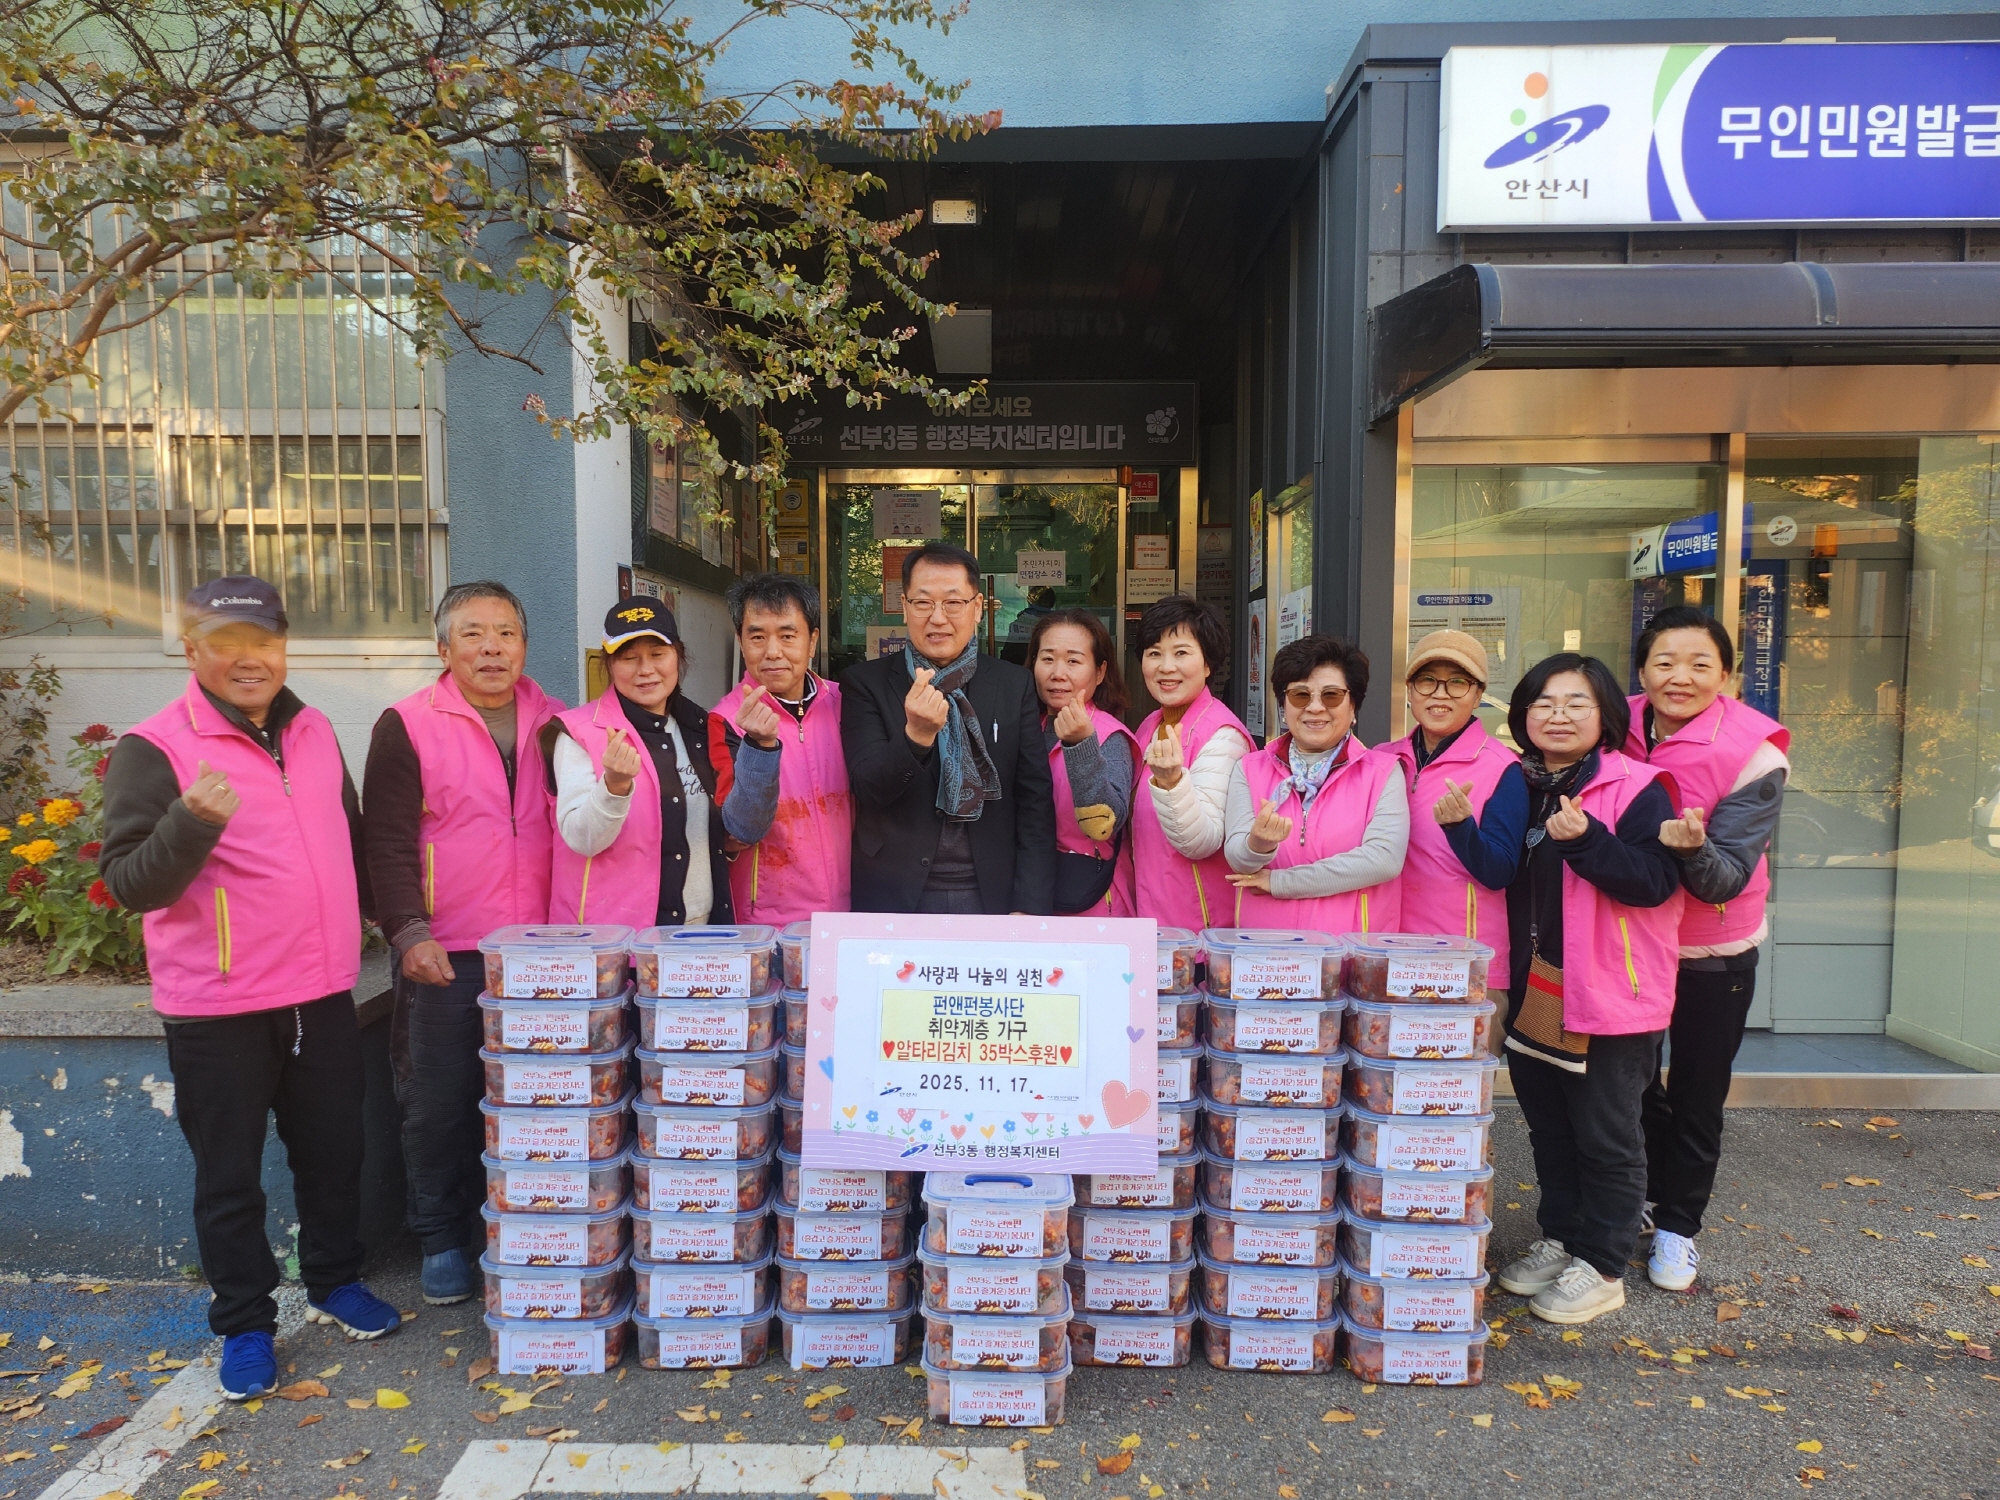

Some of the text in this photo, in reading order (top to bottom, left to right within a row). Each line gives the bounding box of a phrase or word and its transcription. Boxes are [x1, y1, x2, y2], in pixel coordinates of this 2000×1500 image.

[1718, 105, 2000, 160] 무인민원발급
[1504, 177, 1589, 201] 안산시
[786, 435, 823, 445] 안산시
[839, 424, 1126, 451] 선부3동 행정복지센터입니다
[1022, 560, 1061, 569] 주민자치회
[1020, 570, 1063, 579] 면접장소 2층
[221, 596, 263, 605] Columbia
[565, 975, 588, 983] 봉사단
[720, 974, 742, 982] 봉사단
[918, 965, 1043, 988] 사랑과 나눔의 실천
[1290, 975, 1312, 983] 봉사단
[1443, 973, 1465, 981] 봉사단
[933, 995, 1025, 1018] 펀앤펀봉사단
[560, 1024, 583, 1033] 봉사단
[928, 1018, 1028, 1042] 취약계층 가구
[896, 1040, 1058, 1066] 알타리김치 35박스후원
[717, 1080, 739, 1088] 봉사단
[920, 1074, 1034, 1094] 2025. 11. 17.
[1296, 1079, 1319, 1087] 봉사단
[1452, 1090, 1474, 1098] 봉사단
[558, 1138, 581, 1146] 봉사단
[933, 1143, 1060, 1160] 선부3동 행정복지센터
[709, 1189, 731, 1197] 봉사단
[857, 1188, 878, 1196] 봉사단
[1291, 1188, 1313, 1196] 봉사단
[1011, 1232, 1035, 1240] 봉사단
[707, 1239, 729, 1247] 봉사단
[1141, 1238, 1162, 1246] 봉사단
[559, 1243, 581, 1251] 봉사단
[1440, 1256, 1463, 1264] 봉사단
[1008, 1287, 1032, 1296] 봉사단
[1287, 1296, 1309, 1304] 봉사단
[715, 1343, 737, 1351] 봉사단
[858, 1344, 879, 1352] 봉사단
[1011, 1340, 1035, 1348] 봉사단
[1149, 1341, 1170, 1349] 봉사단
[567, 1351, 589, 1359] 봉사단
[1440, 1360, 1462, 1368] 봉사단
[1013, 1402, 1037, 1410] 봉사단
